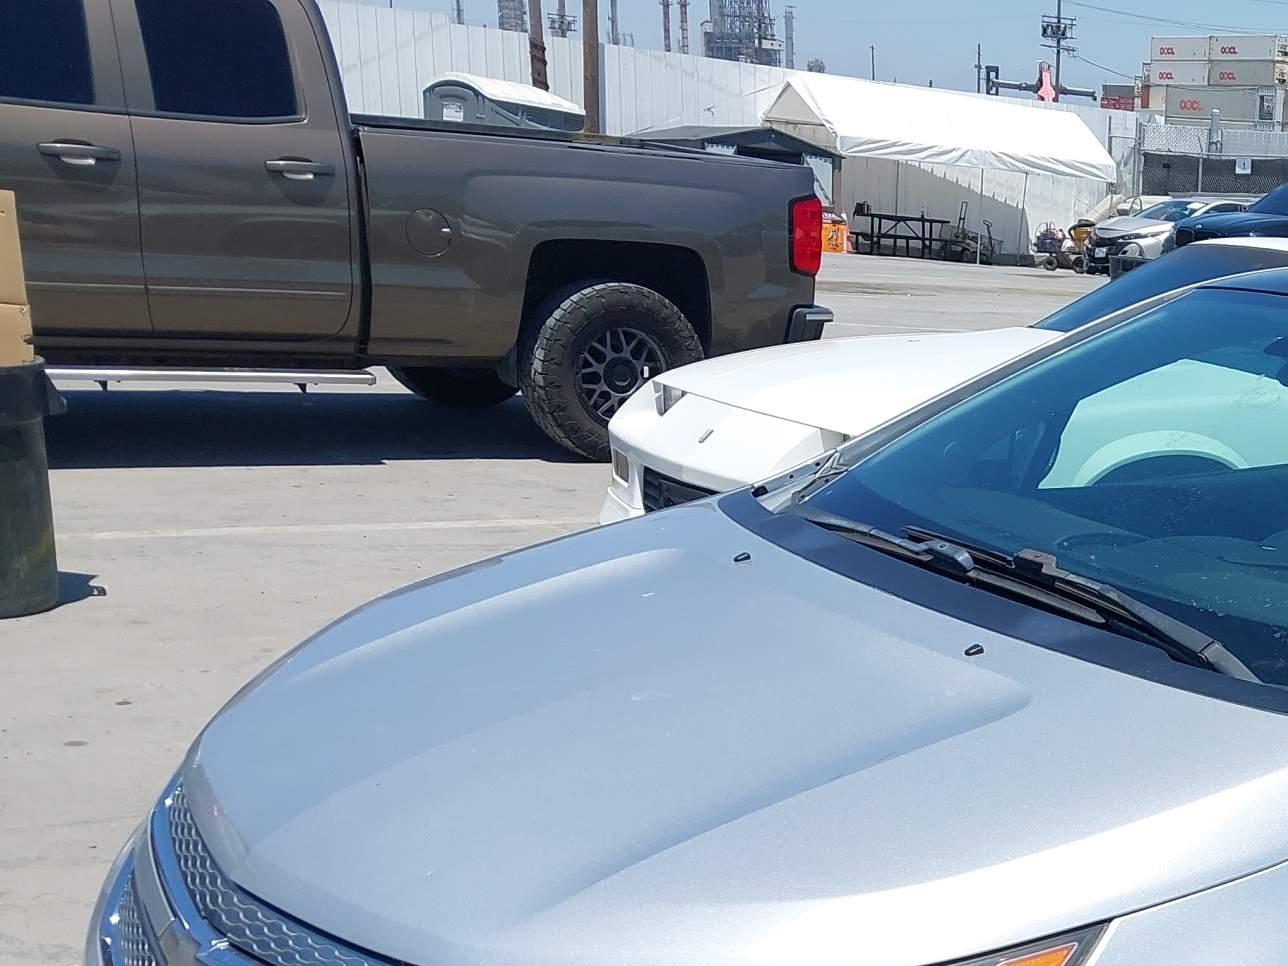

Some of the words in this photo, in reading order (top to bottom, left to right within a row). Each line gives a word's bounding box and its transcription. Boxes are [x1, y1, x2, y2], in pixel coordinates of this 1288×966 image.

[1159, 46, 1175, 55] OOCL
[1220, 46, 1238, 55] OOCL
[1158, 71, 1174, 80] OOCL
[1219, 71, 1236, 80] OOCL
